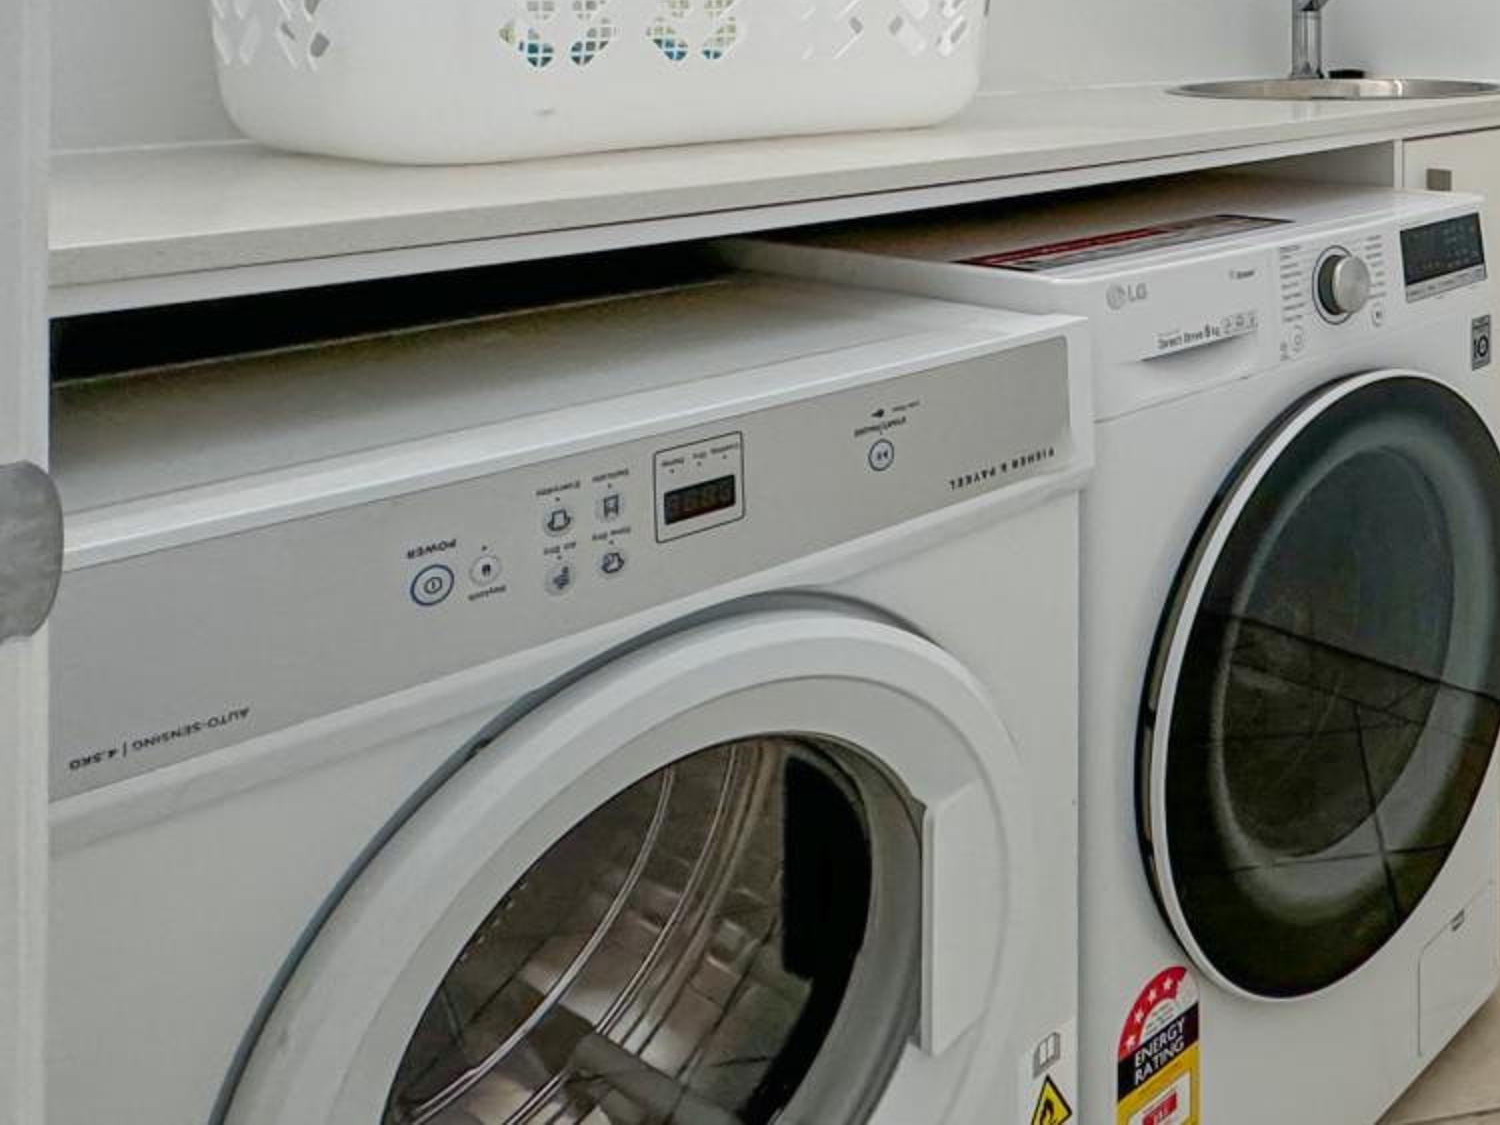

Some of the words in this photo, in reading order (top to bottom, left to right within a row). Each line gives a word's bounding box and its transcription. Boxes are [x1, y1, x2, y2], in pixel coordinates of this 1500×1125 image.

[1011, 447, 1055, 470] FISHER
[949, 466, 996, 490] PAYKEL
[406, 538, 457, 559] POWER
[1135, 1016, 1185, 1067] ENERGY
[1135, 1035, 1185, 1086] RATING
